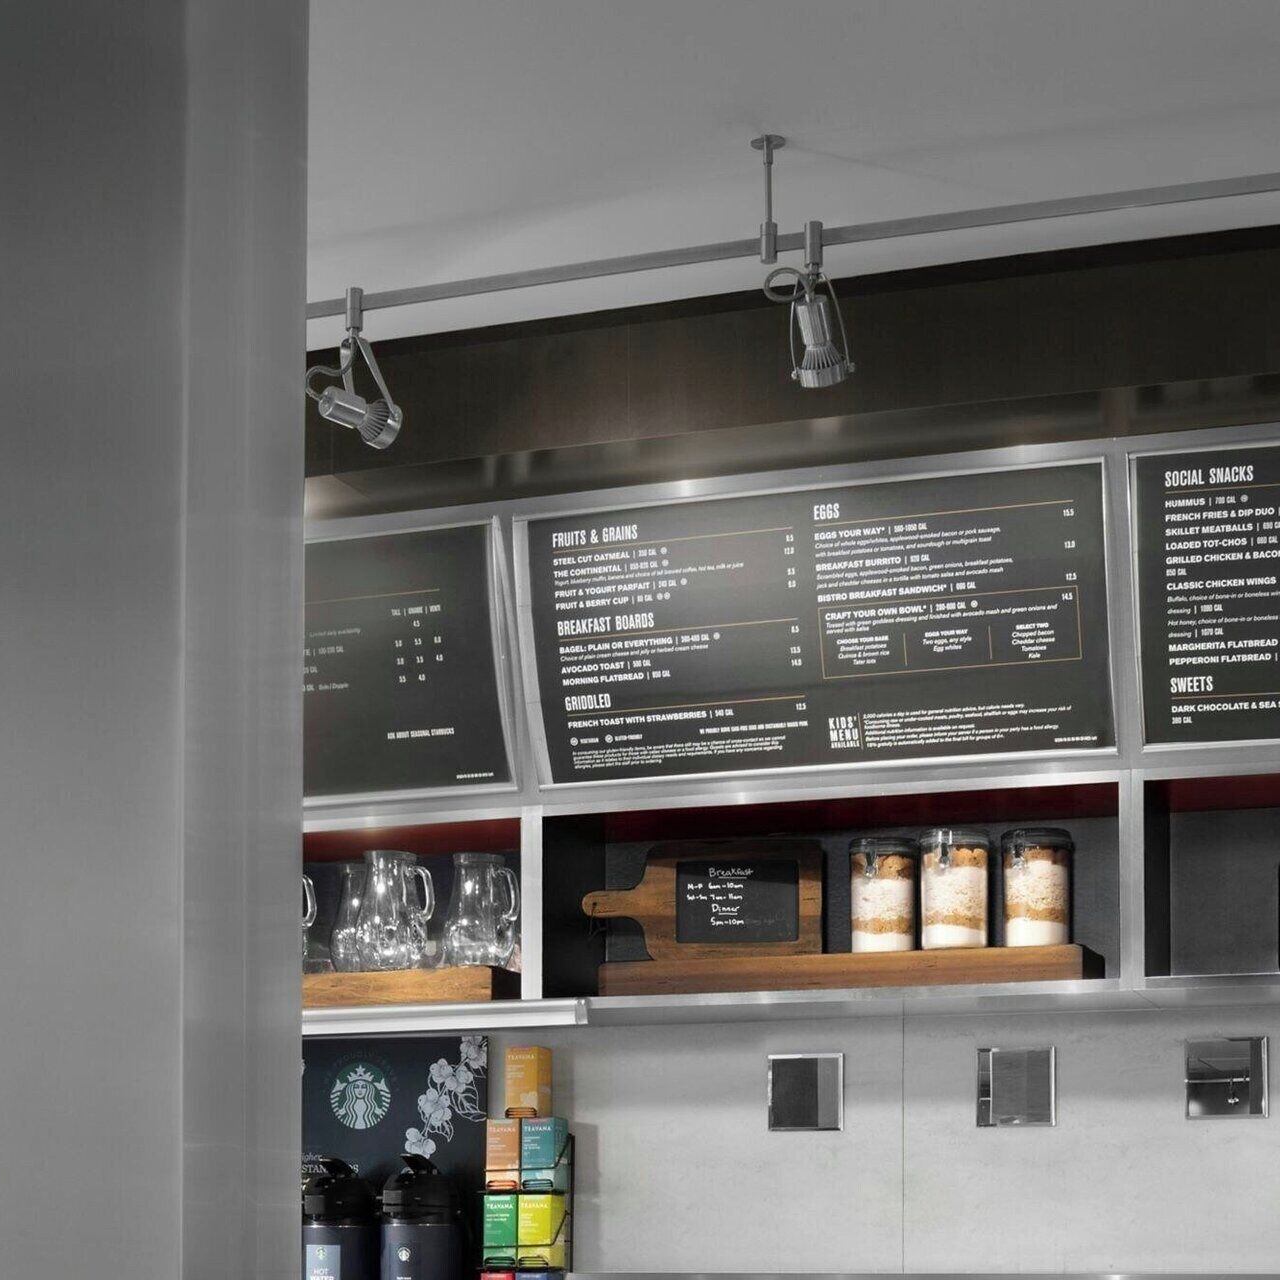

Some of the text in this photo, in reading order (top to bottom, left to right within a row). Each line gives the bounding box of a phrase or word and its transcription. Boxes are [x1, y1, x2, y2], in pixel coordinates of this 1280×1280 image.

[1165, 465, 1253, 486] SOCIAL SNACKS
[1165, 498, 1205, 507] HUMMUS
[814, 503, 839, 520] EGGS
[1165, 512, 1200, 521] FRENCH
[1202, 510, 1228, 518] FRIES
[1238, 508, 1253, 516] DIP
[1255, 507, 1274, 515] DUO
[552, 524, 637, 547] FRUITS & GRAINS
[814, 531, 836, 540] EGGS
[838, 529, 861, 537] YOUR
[1165, 523, 1252, 535] SKILLET MEATBALLS
[1166, 537, 1246, 549] LOADED TOT-CHOS
[553, 557, 576, 565] STEEL
[594, 551, 629, 561] OATMEAL
[816, 556, 901, 571] BREAKFAST BURRITO
[1166, 555, 1202, 564] GRILLED
[1204, 552, 1242, 561] CHICKEN
[570, 564, 621, 575] CONTINENTAL
[1166, 576, 1276, 590] CLASSIC CHICKEN WINGS
[817, 593, 847, 602] BISTRO
[849, 588, 896, 599] BREAKFAST
[825, 611, 851, 620] CRAFT
[853, 609, 875, 617] YOUR
[877, 607, 897, 616] OWN
[557, 612, 654, 635] BREAKFAST BOARDS
[559, 645, 586, 653] BAGEL:
[624, 636, 672, 647] EVERYTHING
[1169, 639, 1278, 651] MARGHERITA FLATBREAD
[1169, 653, 1271, 665] PEPPERONI FLATBREAD
[561, 661, 624, 673] AVOCADO TOAST
[562, 672, 643, 685] MORNING FLATBREAD
[1170, 676, 1212, 692] SWEETS
[565, 693, 610, 710] GRIDDLED
[1197, 702, 1248, 711] CHOCOLATE
[568, 720, 598, 728] FRENCH
[599, 717, 623, 725] TOAST
[646, 710, 706, 722] STRAWBERRIES
[828, 716, 856, 730] KIDS'
[830, 728, 858, 741] MENU
[709, 867, 753, 877] Breakfast
[711, 903, 740, 912] Dinner
